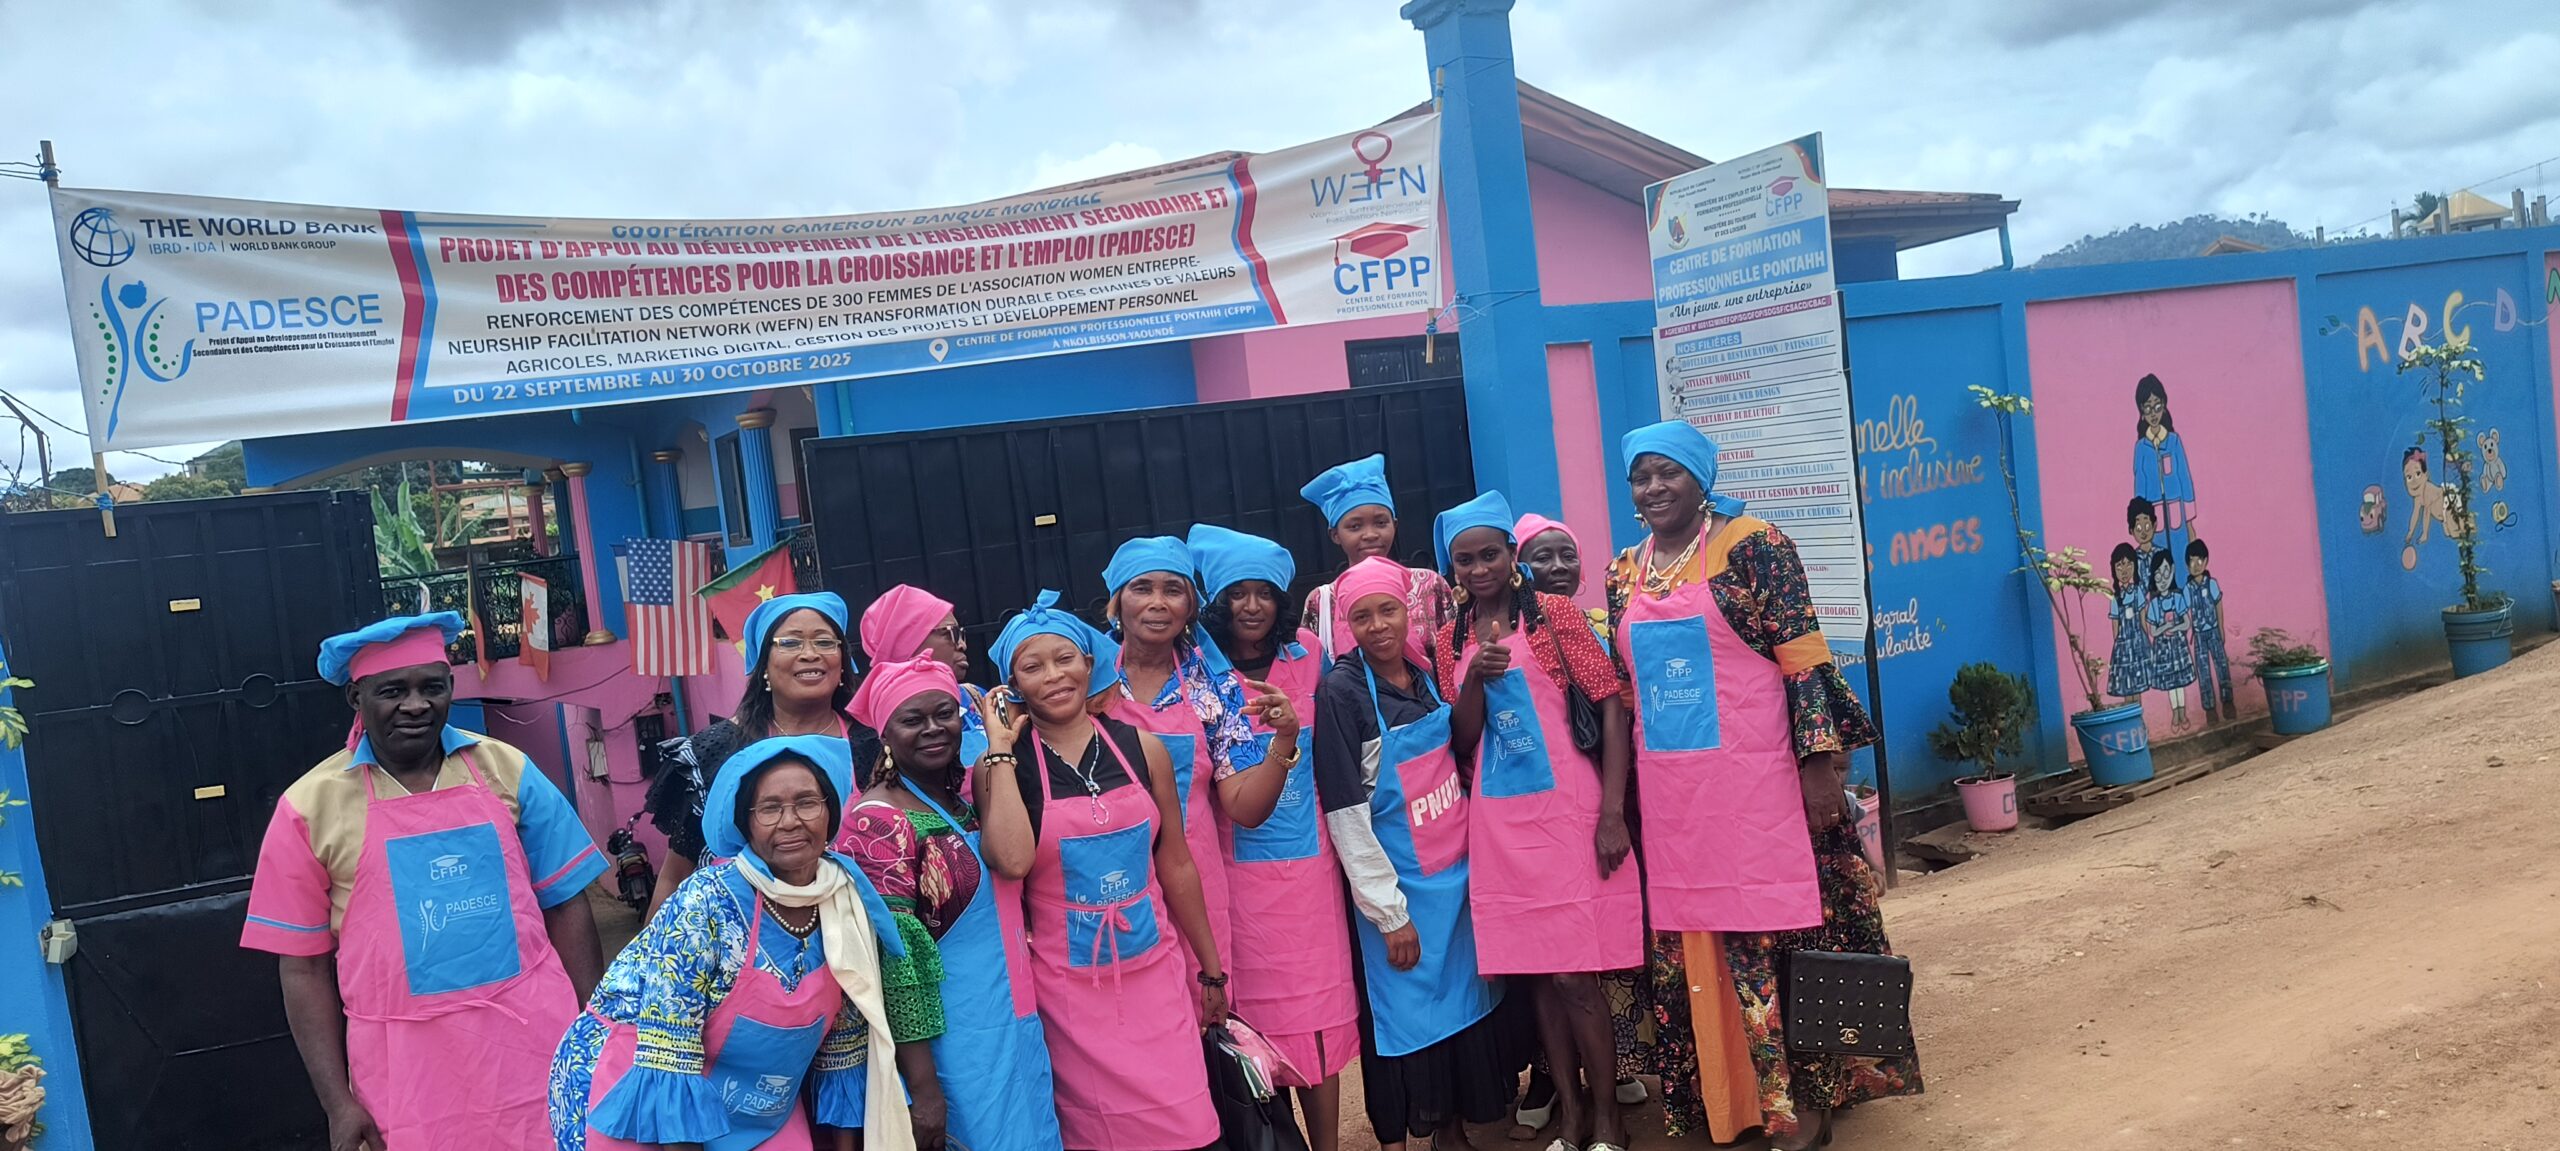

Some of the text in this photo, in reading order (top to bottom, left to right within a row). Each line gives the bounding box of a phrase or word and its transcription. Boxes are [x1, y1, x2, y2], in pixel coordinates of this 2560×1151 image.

[612, 191, 1104, 239] COOPÉRATION MONDIALE
[1765, 192, 1803, 217] CFPP
[139, 217, 377, 238] THE WORLD BANK
[439, 187, 1229, 263] PROJET D'APPUI AU DÉVELOPPEMENT DE L'ENSEIGNEMENT SECONDAIRE ET
[148, 240, 336, 255] IBRD IDA WORLD BANK GROUP
[1669, 229, 1801, 276] CENTRE DE FORMATION
[496, 223, 1196, 303] DES COMPÉTENCES POUR LA CROISSANCE ET L'EMPLOI (PADESCE)
[1334, 256, 1430, 295] CFPP
[1658, 250, 1826, 303] PROFESSIONNELLE PONTAHH
[486, 255, 1201, 330] RENFORCEMENT DES COMPÉTENCES DE 300 FEMMES DE L'ASSOCIATION WOMEN ENTREPRE-
[1345, 296, 1374, 305] CENTRE
[1387, 290, 1428, 300] FORMATION
[1724, 296, 1744, 308] une
[195, 293, 383, 333] PADESCE
[448, 266, 1237, 355] NEURSHIP FACILITATION NETWORK (WEFN) EN TRANSFORMATION DURABLE DES CHAINES DE VALEURS
[506, 289, 1199, 375] AGRICOLES, MARKETING DIGITAL, GESTION DES PROJETS ET DÉVELOPPEMENT PERSONNEL
[956, 305, 1256, 347] CENTRE DE FORMATION PROFESSIONNELLE PONTAHH (CFPP)
[2357, 287, 2517, 373] A B C D
[1677, 342, 1696, 354] NOS
[453, 352, 852, 404] DU 22 SEPTEMBRE AU 30 OCTOBRE 2025
[1685, 374, 1714, 388] STYLISTE
[1688, 394, 1730, 407] INFOGRAPHIE
[1738, 390, 1754, 400] WEB
[1755, 386, 1781, 399] DESIGN
[1855, 394, 1937, 455] nelle
[1750, 468, 1759, 478] ET
[1758, 484, 1840, 498] ET GESTION DE PROJET
[1796, 508, 1805, 517] ET
[1890, 515, 1984, 567] ANGES
[1815, 606, 1859, 617] YCHOLOGIE)
[1874, 598, 1918, 636] égral
[1666, 667, 1692, 678] CFPP
[1664, 688, 1701, 700] PADESCE
[1497, 717, 1520, 730] CFPP
[430, 863, 468, 881] CFPP
[1100, 878, 1130, 895] CFPP
[445, 894, 498, 914] PADESCE
[755, 1081, 791, 1097] CFPP
